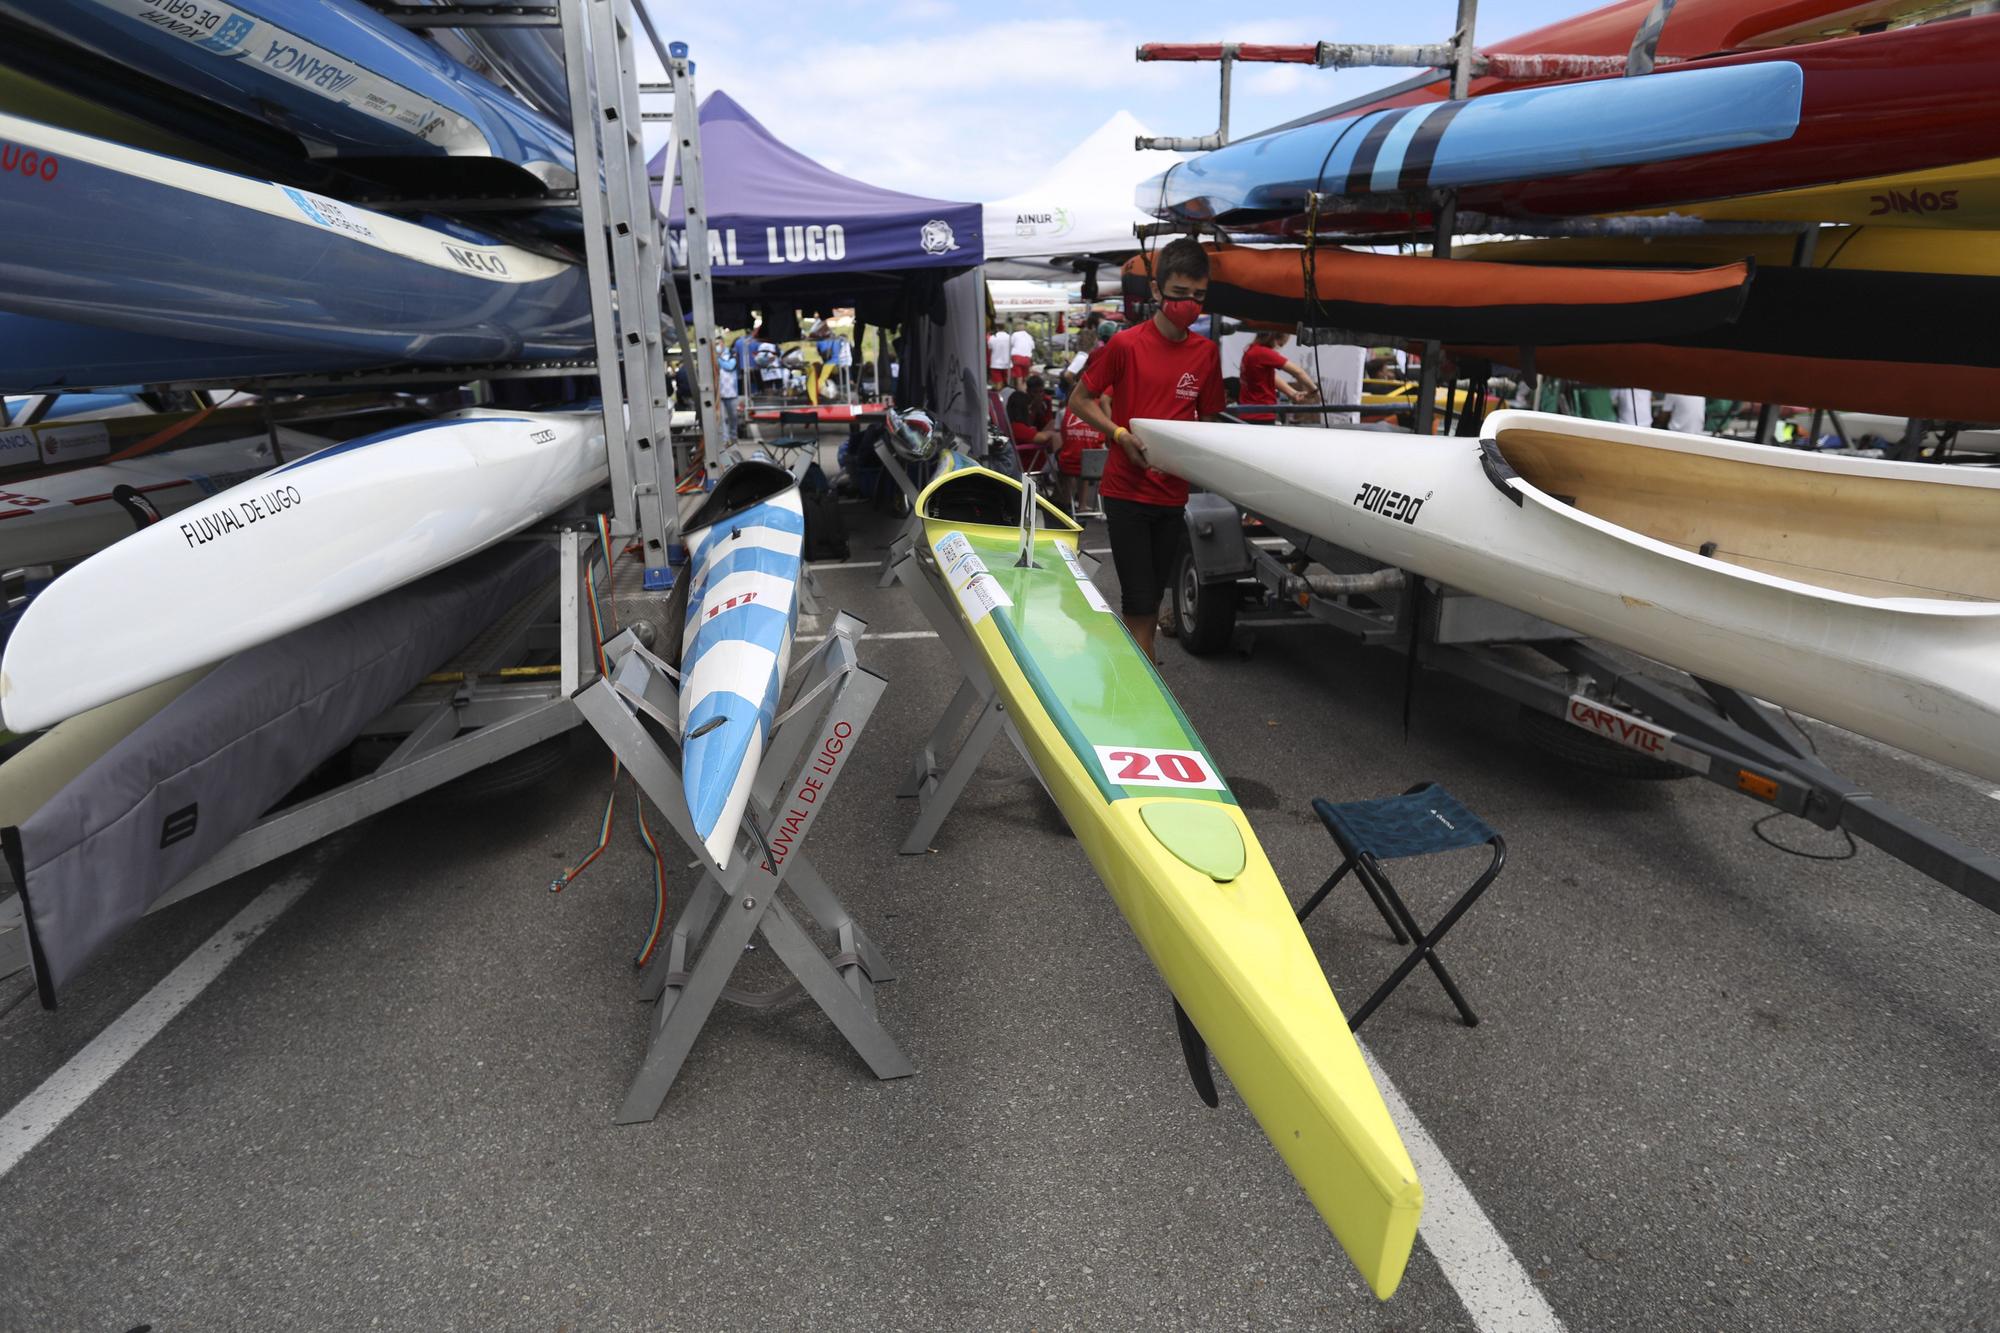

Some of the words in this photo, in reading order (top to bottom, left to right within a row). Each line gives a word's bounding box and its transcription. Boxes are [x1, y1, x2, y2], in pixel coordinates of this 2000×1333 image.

[139, 10, 205, 38] XUNTA
[194, 10, 220, 29] DE
[1016, 214, 1053, 224] AINUR
[766, 224, 846, 263] LUGO
[447, 246, 509, 276] NELO
[180, 507, 245, 548] FLUVIAL
[240, 499, 265, 523] DE
[261, 485, 301, 515] LUGO
[798, 776, 824, 804] DE
[813, 721, 852, 775] LUGO
[1109, 752, 1207, 783] 20
